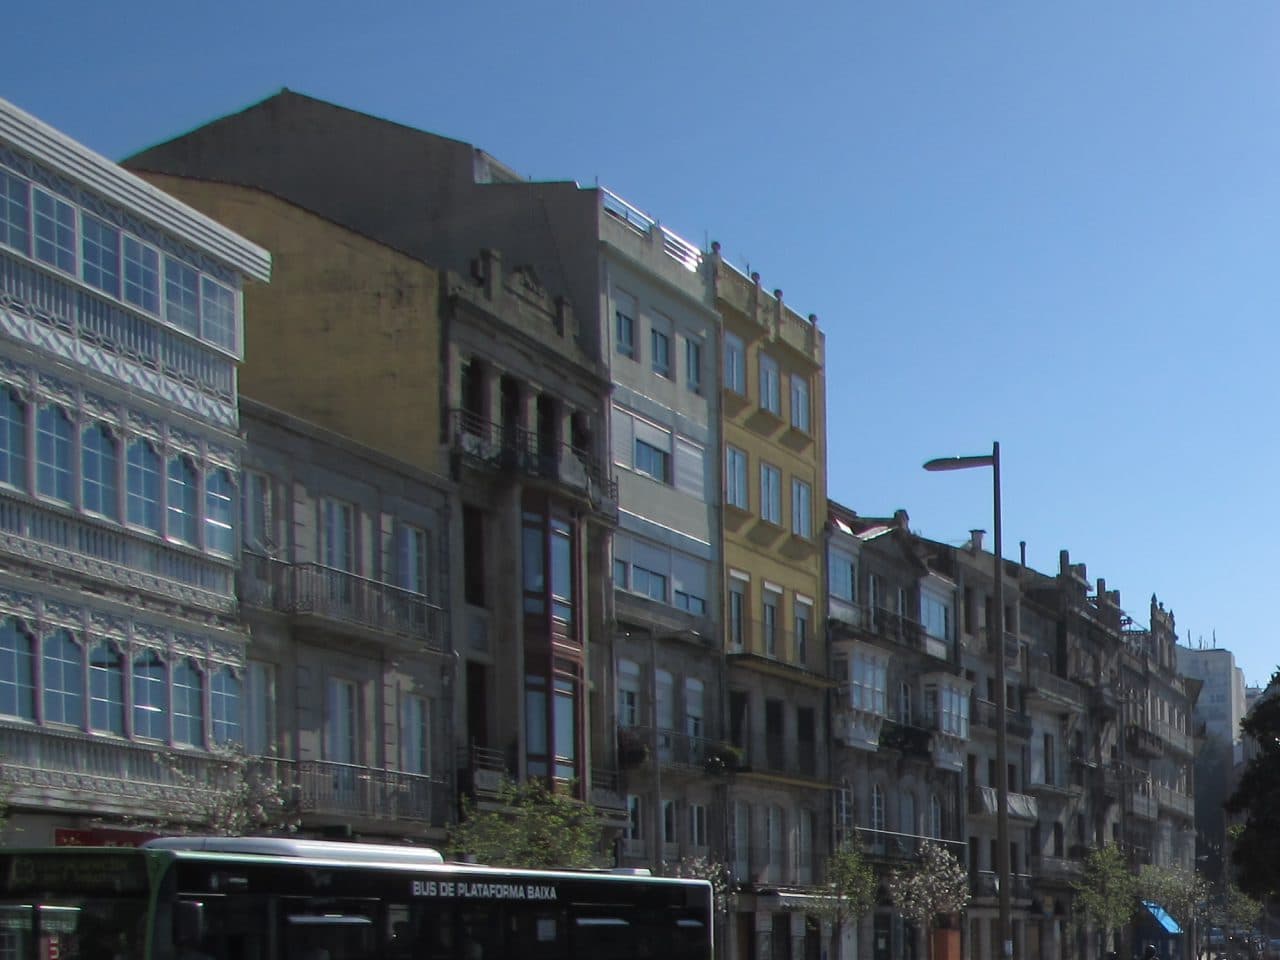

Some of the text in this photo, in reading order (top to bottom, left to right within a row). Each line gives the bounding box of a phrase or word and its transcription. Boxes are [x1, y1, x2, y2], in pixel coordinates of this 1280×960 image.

[413, 881, 557, 900] BUS DE PLATAFORMA BAIXA
